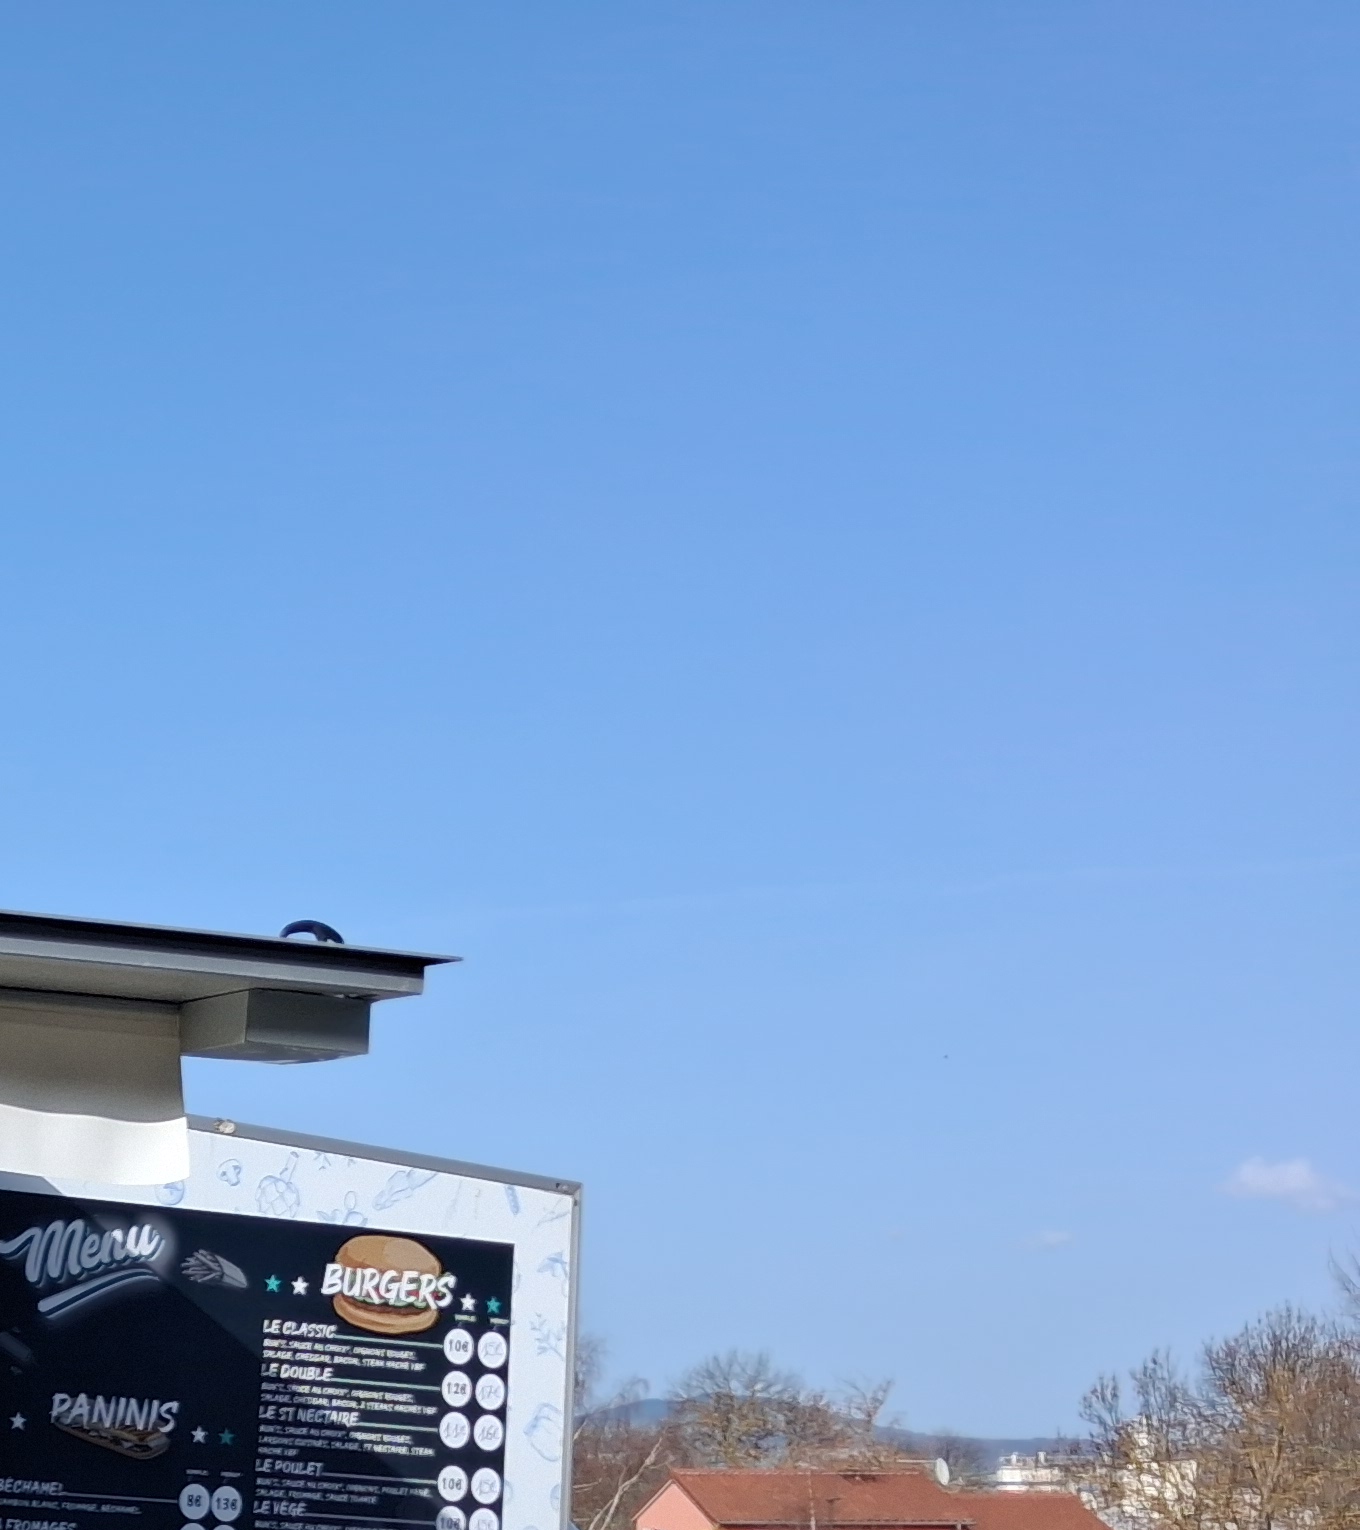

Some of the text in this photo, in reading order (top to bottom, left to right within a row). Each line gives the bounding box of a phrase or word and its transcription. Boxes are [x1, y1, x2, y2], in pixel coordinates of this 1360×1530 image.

[320, 1263, 457, 1309] BURGERS
[263, 1319, 337, 1338] LE CLASSIC
[261, 1363, 334, 1381] LE DOUBLE
[50, 1392, 180, 1432] PANINIS
[258, 1405, 359, 1427] LE ST NECTAIRE
[255, 1459, 324, 1476] LE POULET
[253, 1501, 270, 1514] LE
